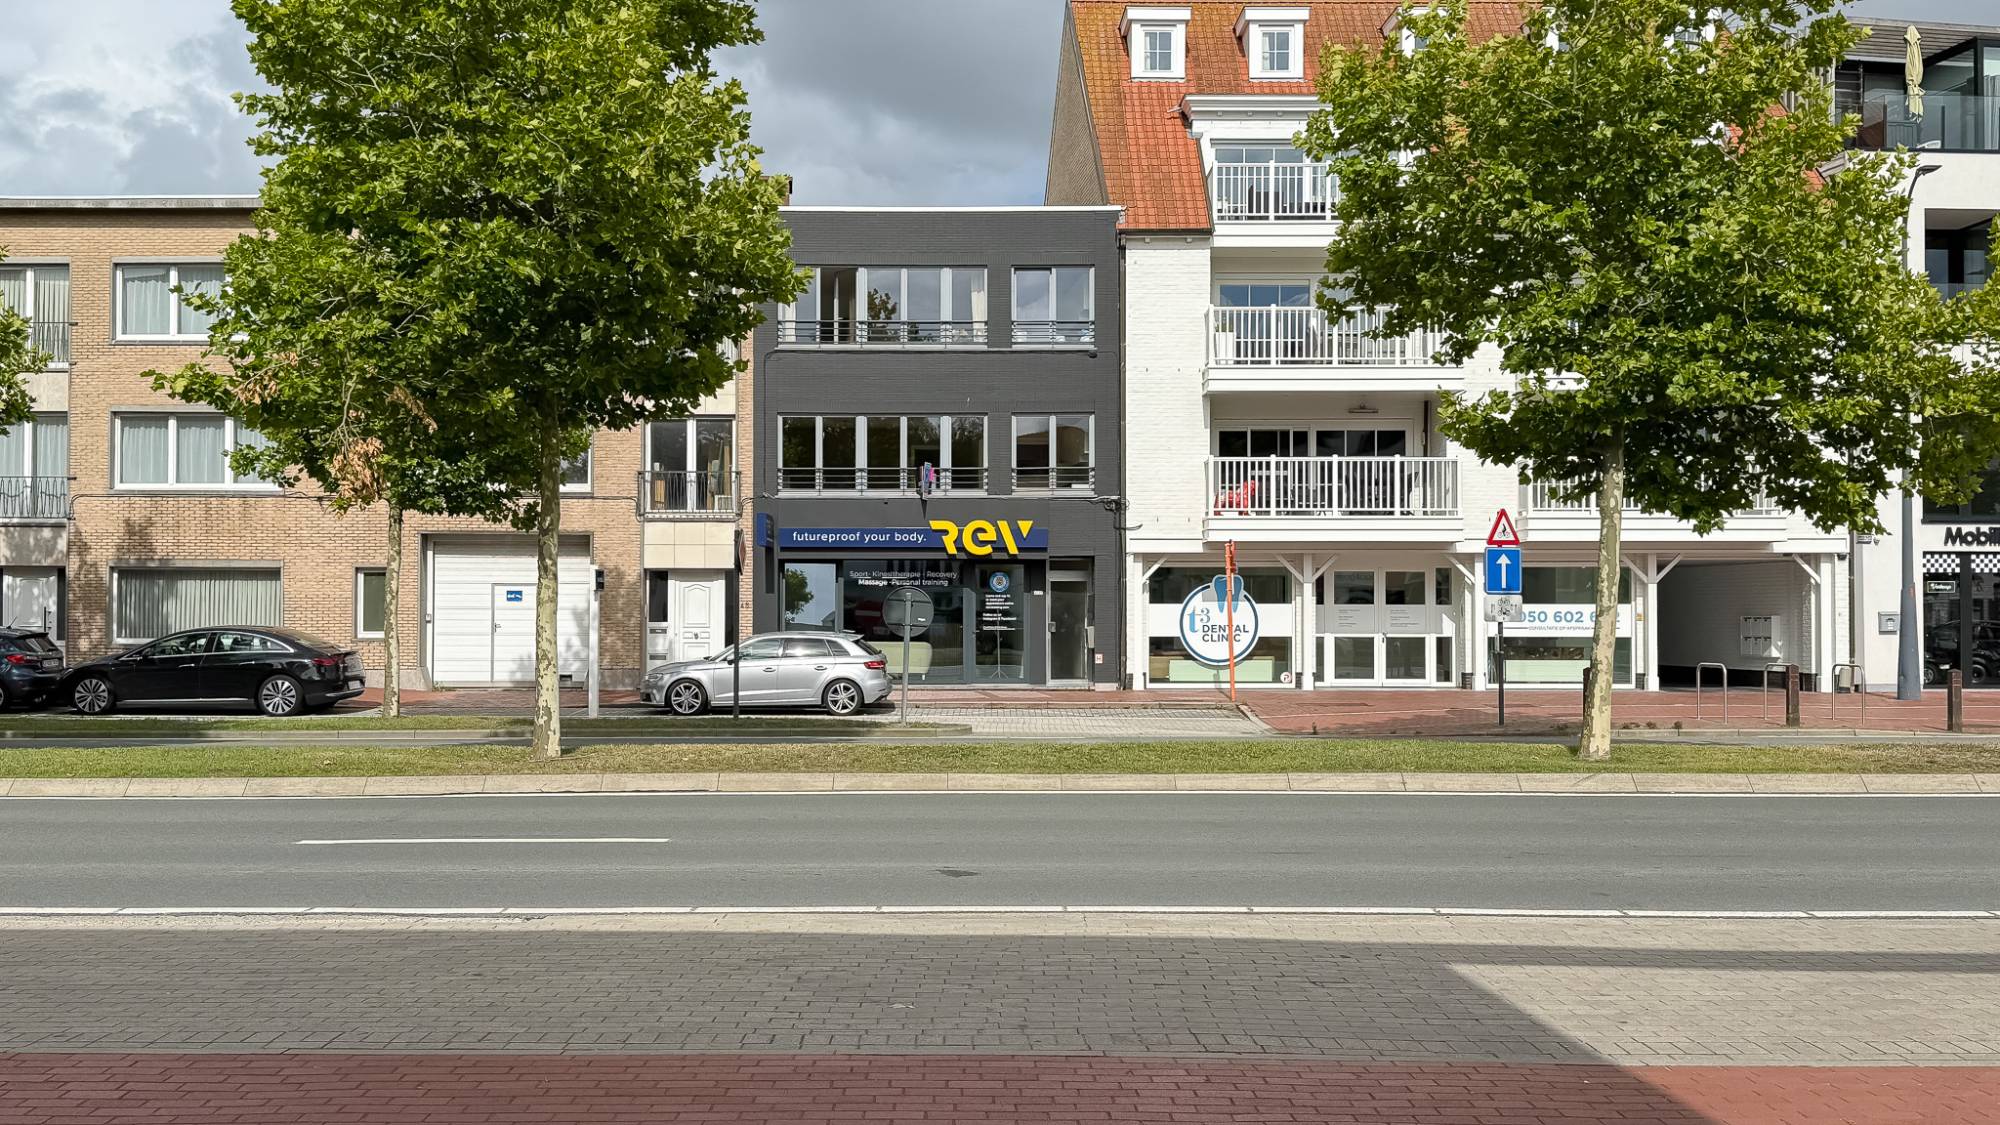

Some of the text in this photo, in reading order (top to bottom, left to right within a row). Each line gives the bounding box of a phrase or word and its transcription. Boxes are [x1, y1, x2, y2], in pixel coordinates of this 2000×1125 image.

[793, 531, 927, 544] futureproof your body.
[926, 570, 958, 579] Recovery
[858, 579, 888, 587] Massage
[922, 579, 949, 587] training
[1553, 610, 1584, 623] 602
[1202, 633, 1241, 642] CLINC
